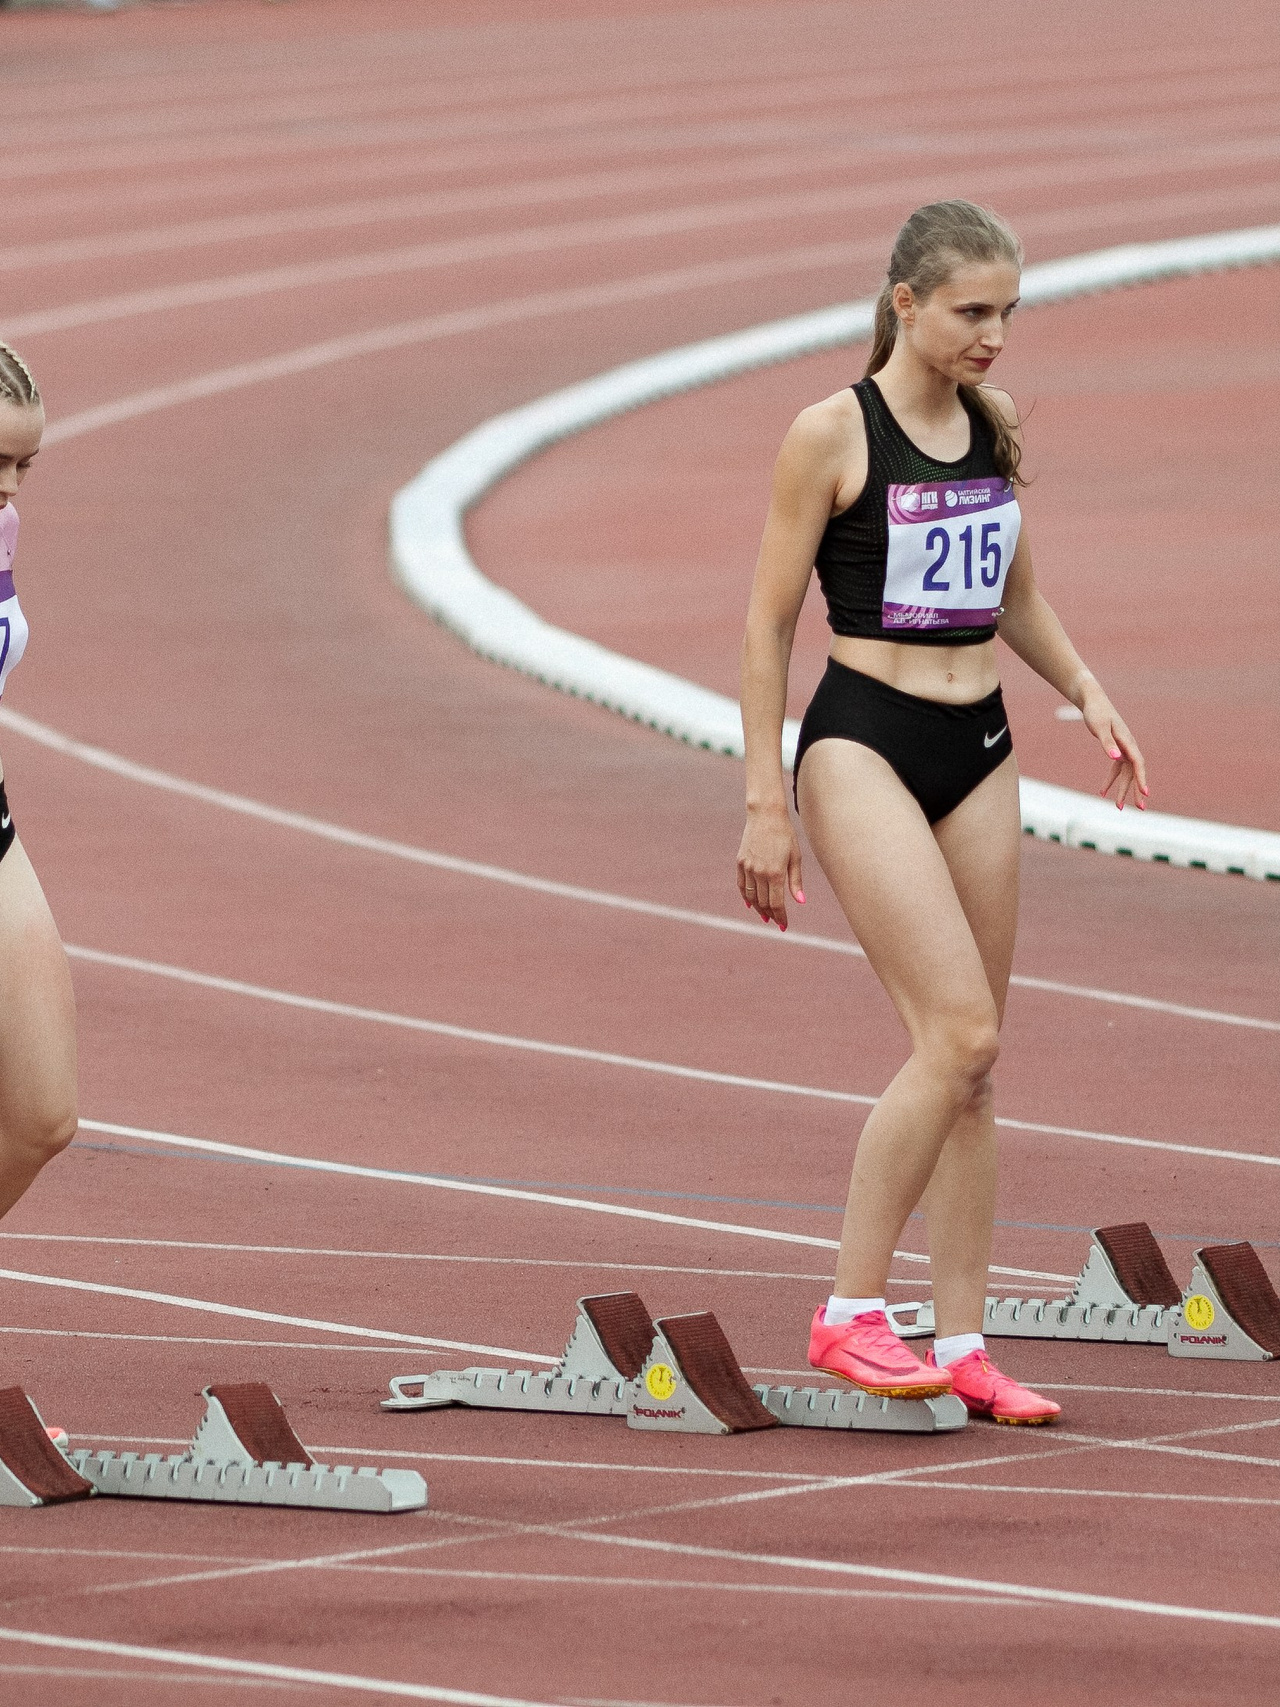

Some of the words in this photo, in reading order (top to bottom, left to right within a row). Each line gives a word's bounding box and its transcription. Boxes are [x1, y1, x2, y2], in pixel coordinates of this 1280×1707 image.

[958, 494, 992, 505] ЛИЗИНГ
[922, 522, 1002, 591] 215
[1180, 1335, 1226, 1346] POLANIK
[635, 1407, 683, 1418] POLANIK
